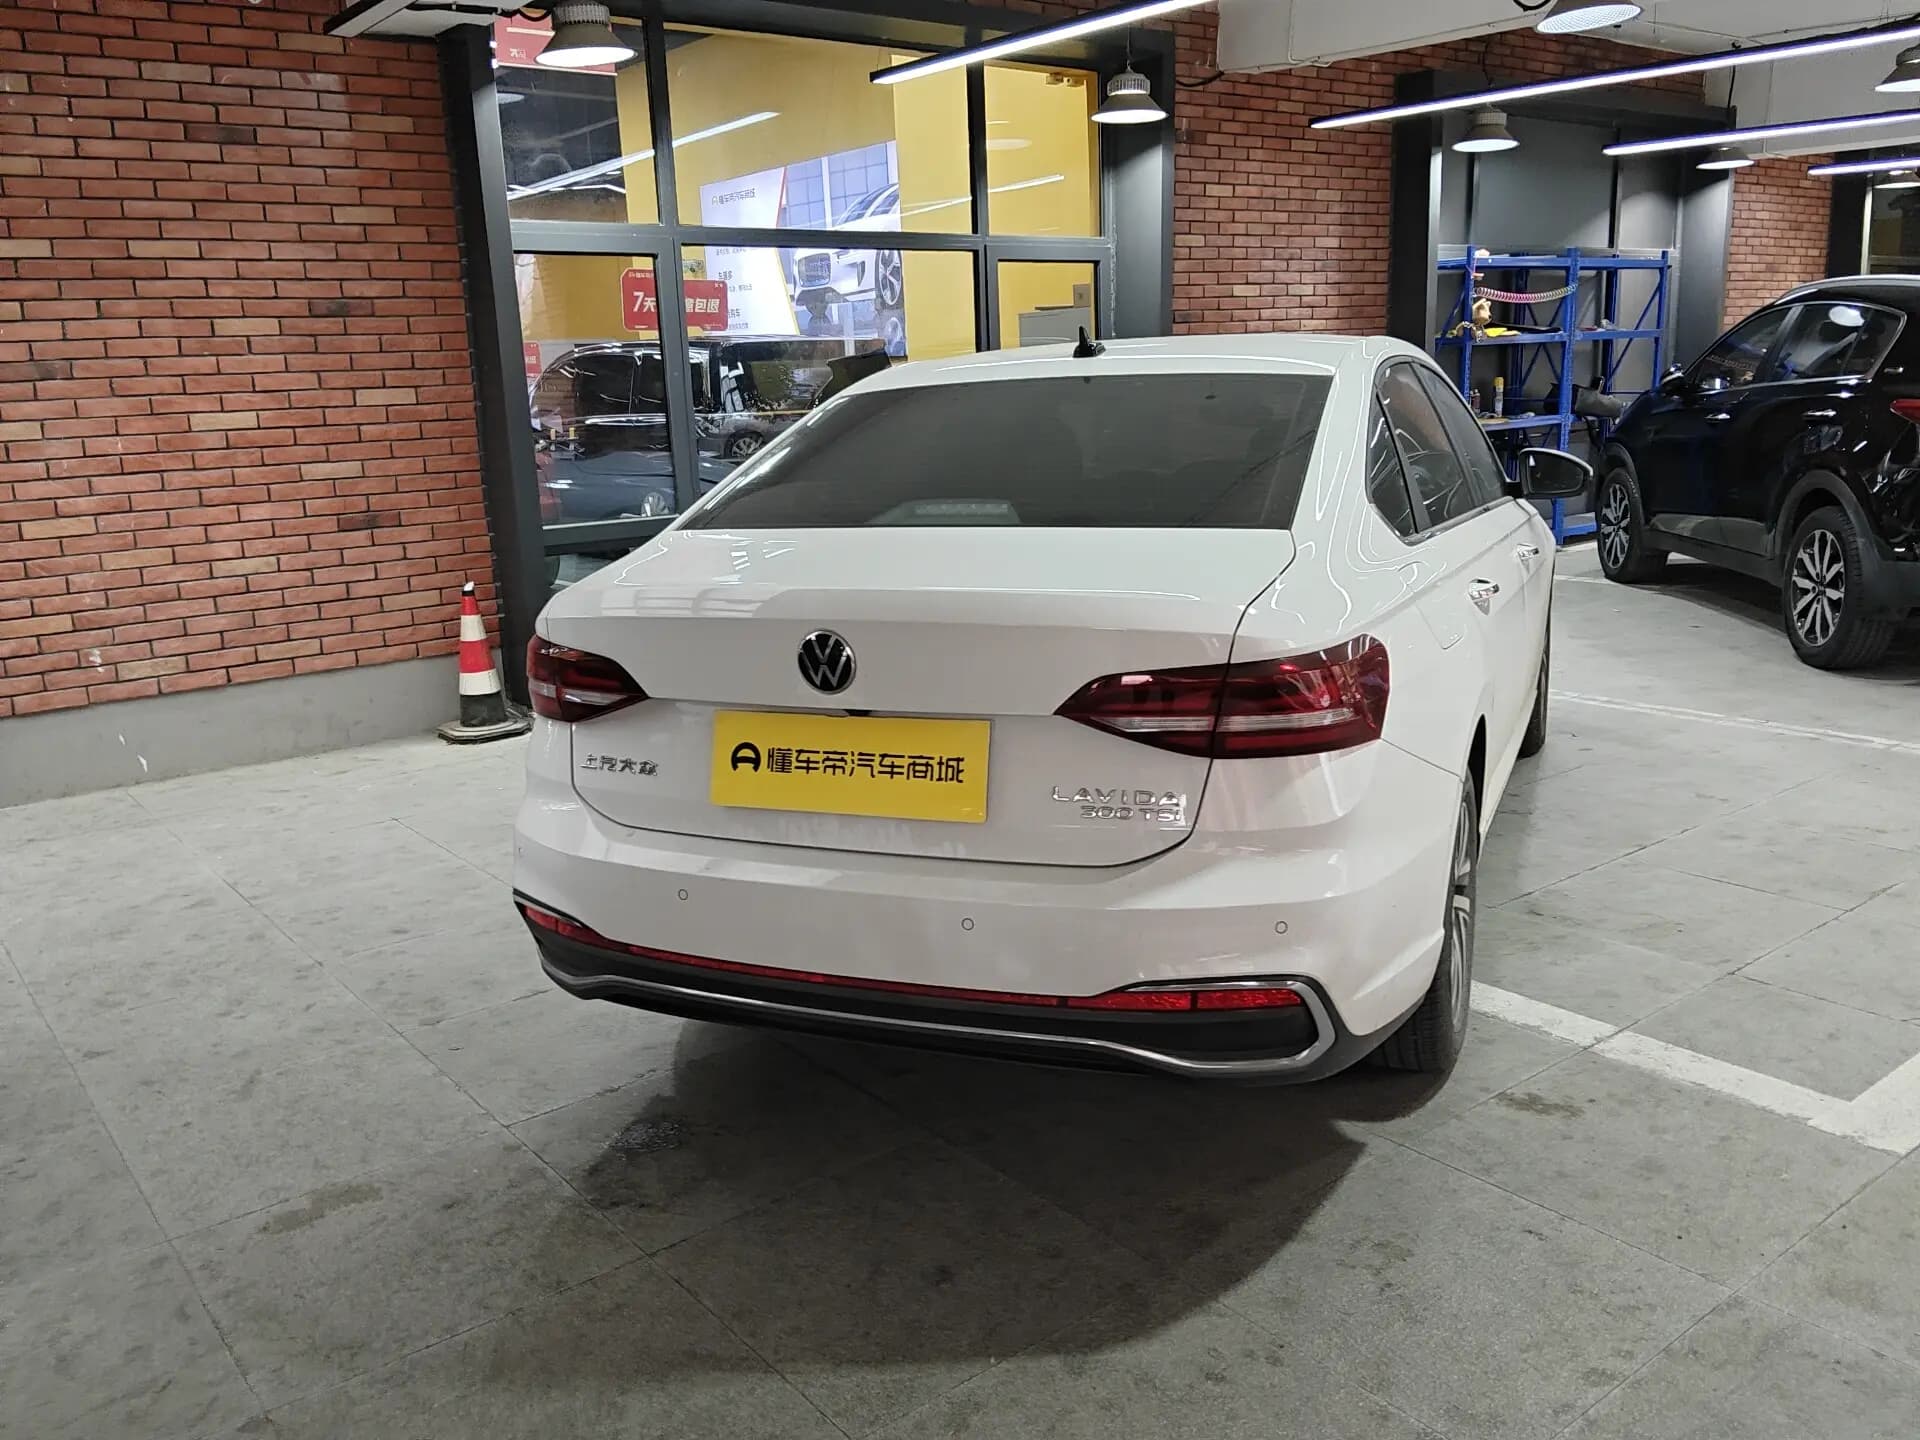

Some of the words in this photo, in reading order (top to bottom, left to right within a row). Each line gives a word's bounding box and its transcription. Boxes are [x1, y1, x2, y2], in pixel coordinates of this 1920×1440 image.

[766, 747, 966, 784] 懂车帝汽车商城
[1052, 785, 1180, 807] LAVIDA
[1080, 805, 1134, 820] 300
